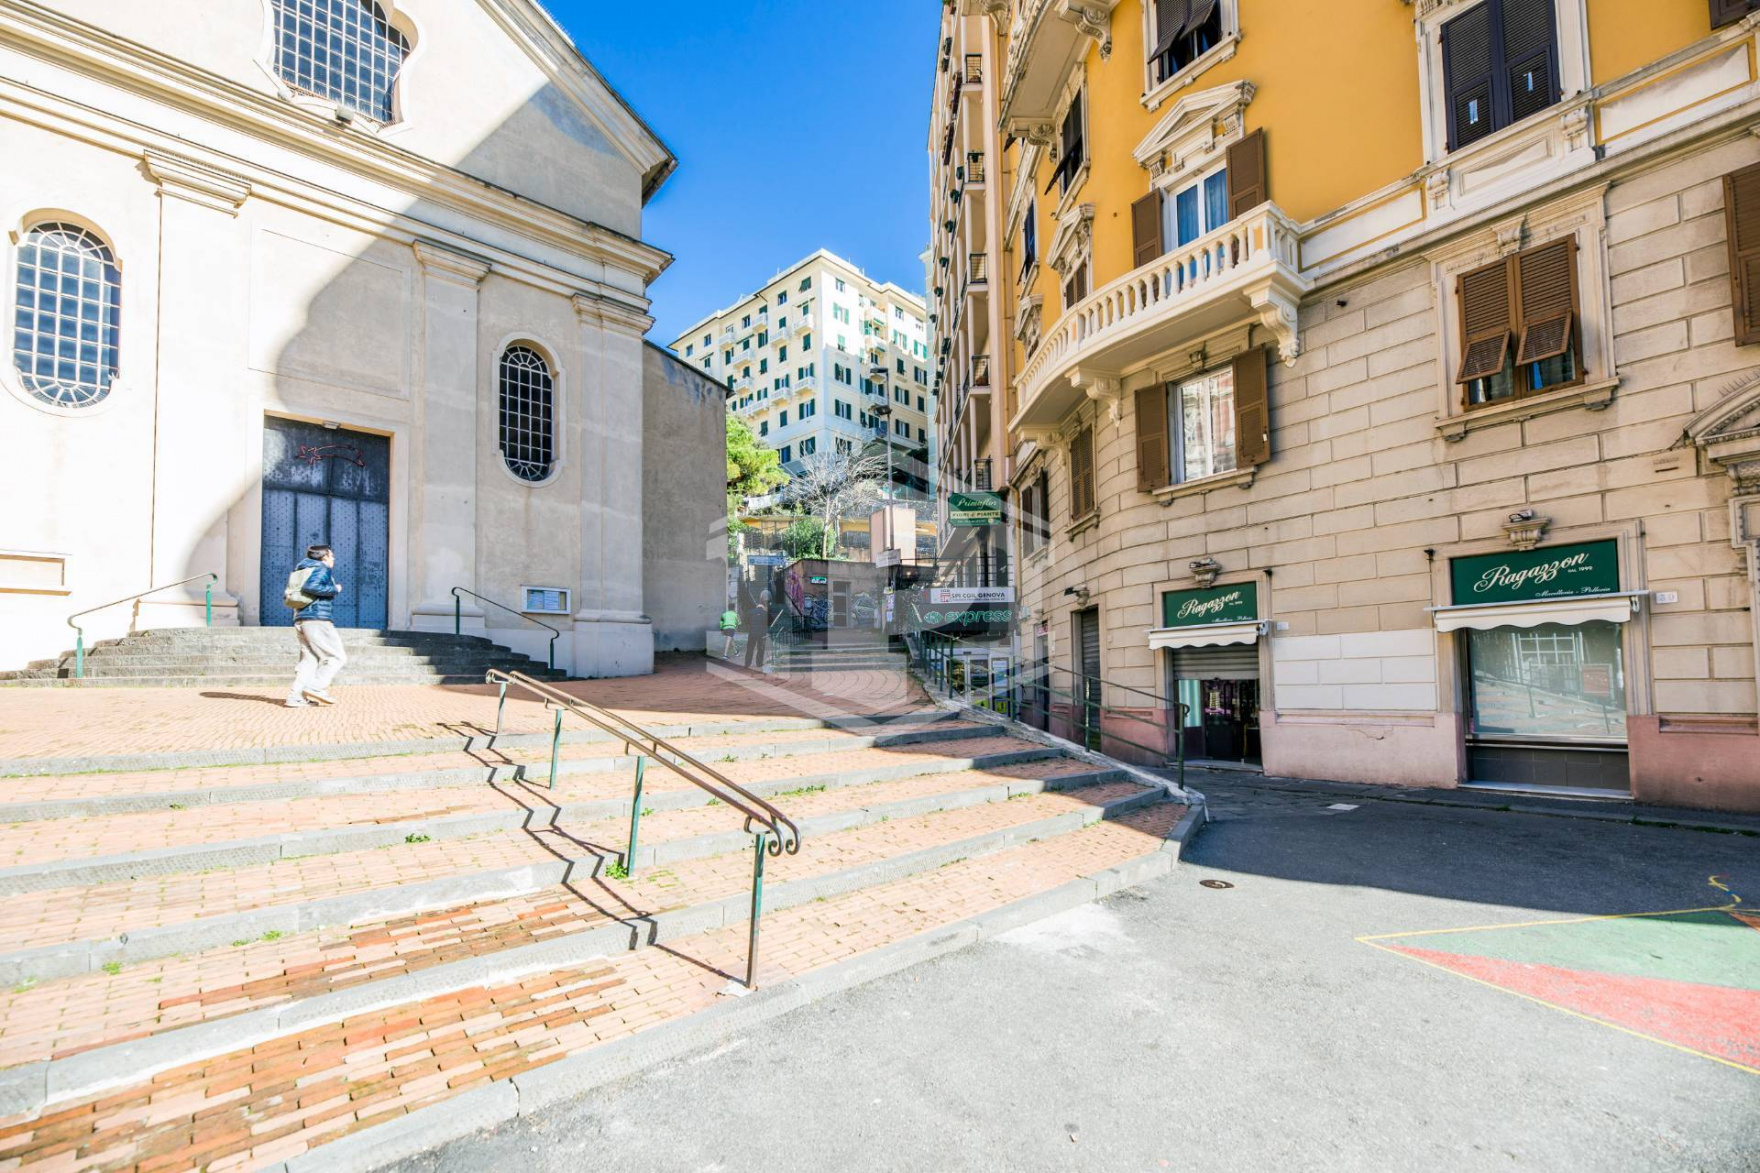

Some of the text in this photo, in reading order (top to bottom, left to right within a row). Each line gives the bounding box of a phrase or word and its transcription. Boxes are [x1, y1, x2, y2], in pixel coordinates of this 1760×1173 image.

[1473, 551, 1589, 593] Ragazzon
[944, 610, 1013, 626] express
[1177, 591, 1241, 618] Ragazzon
